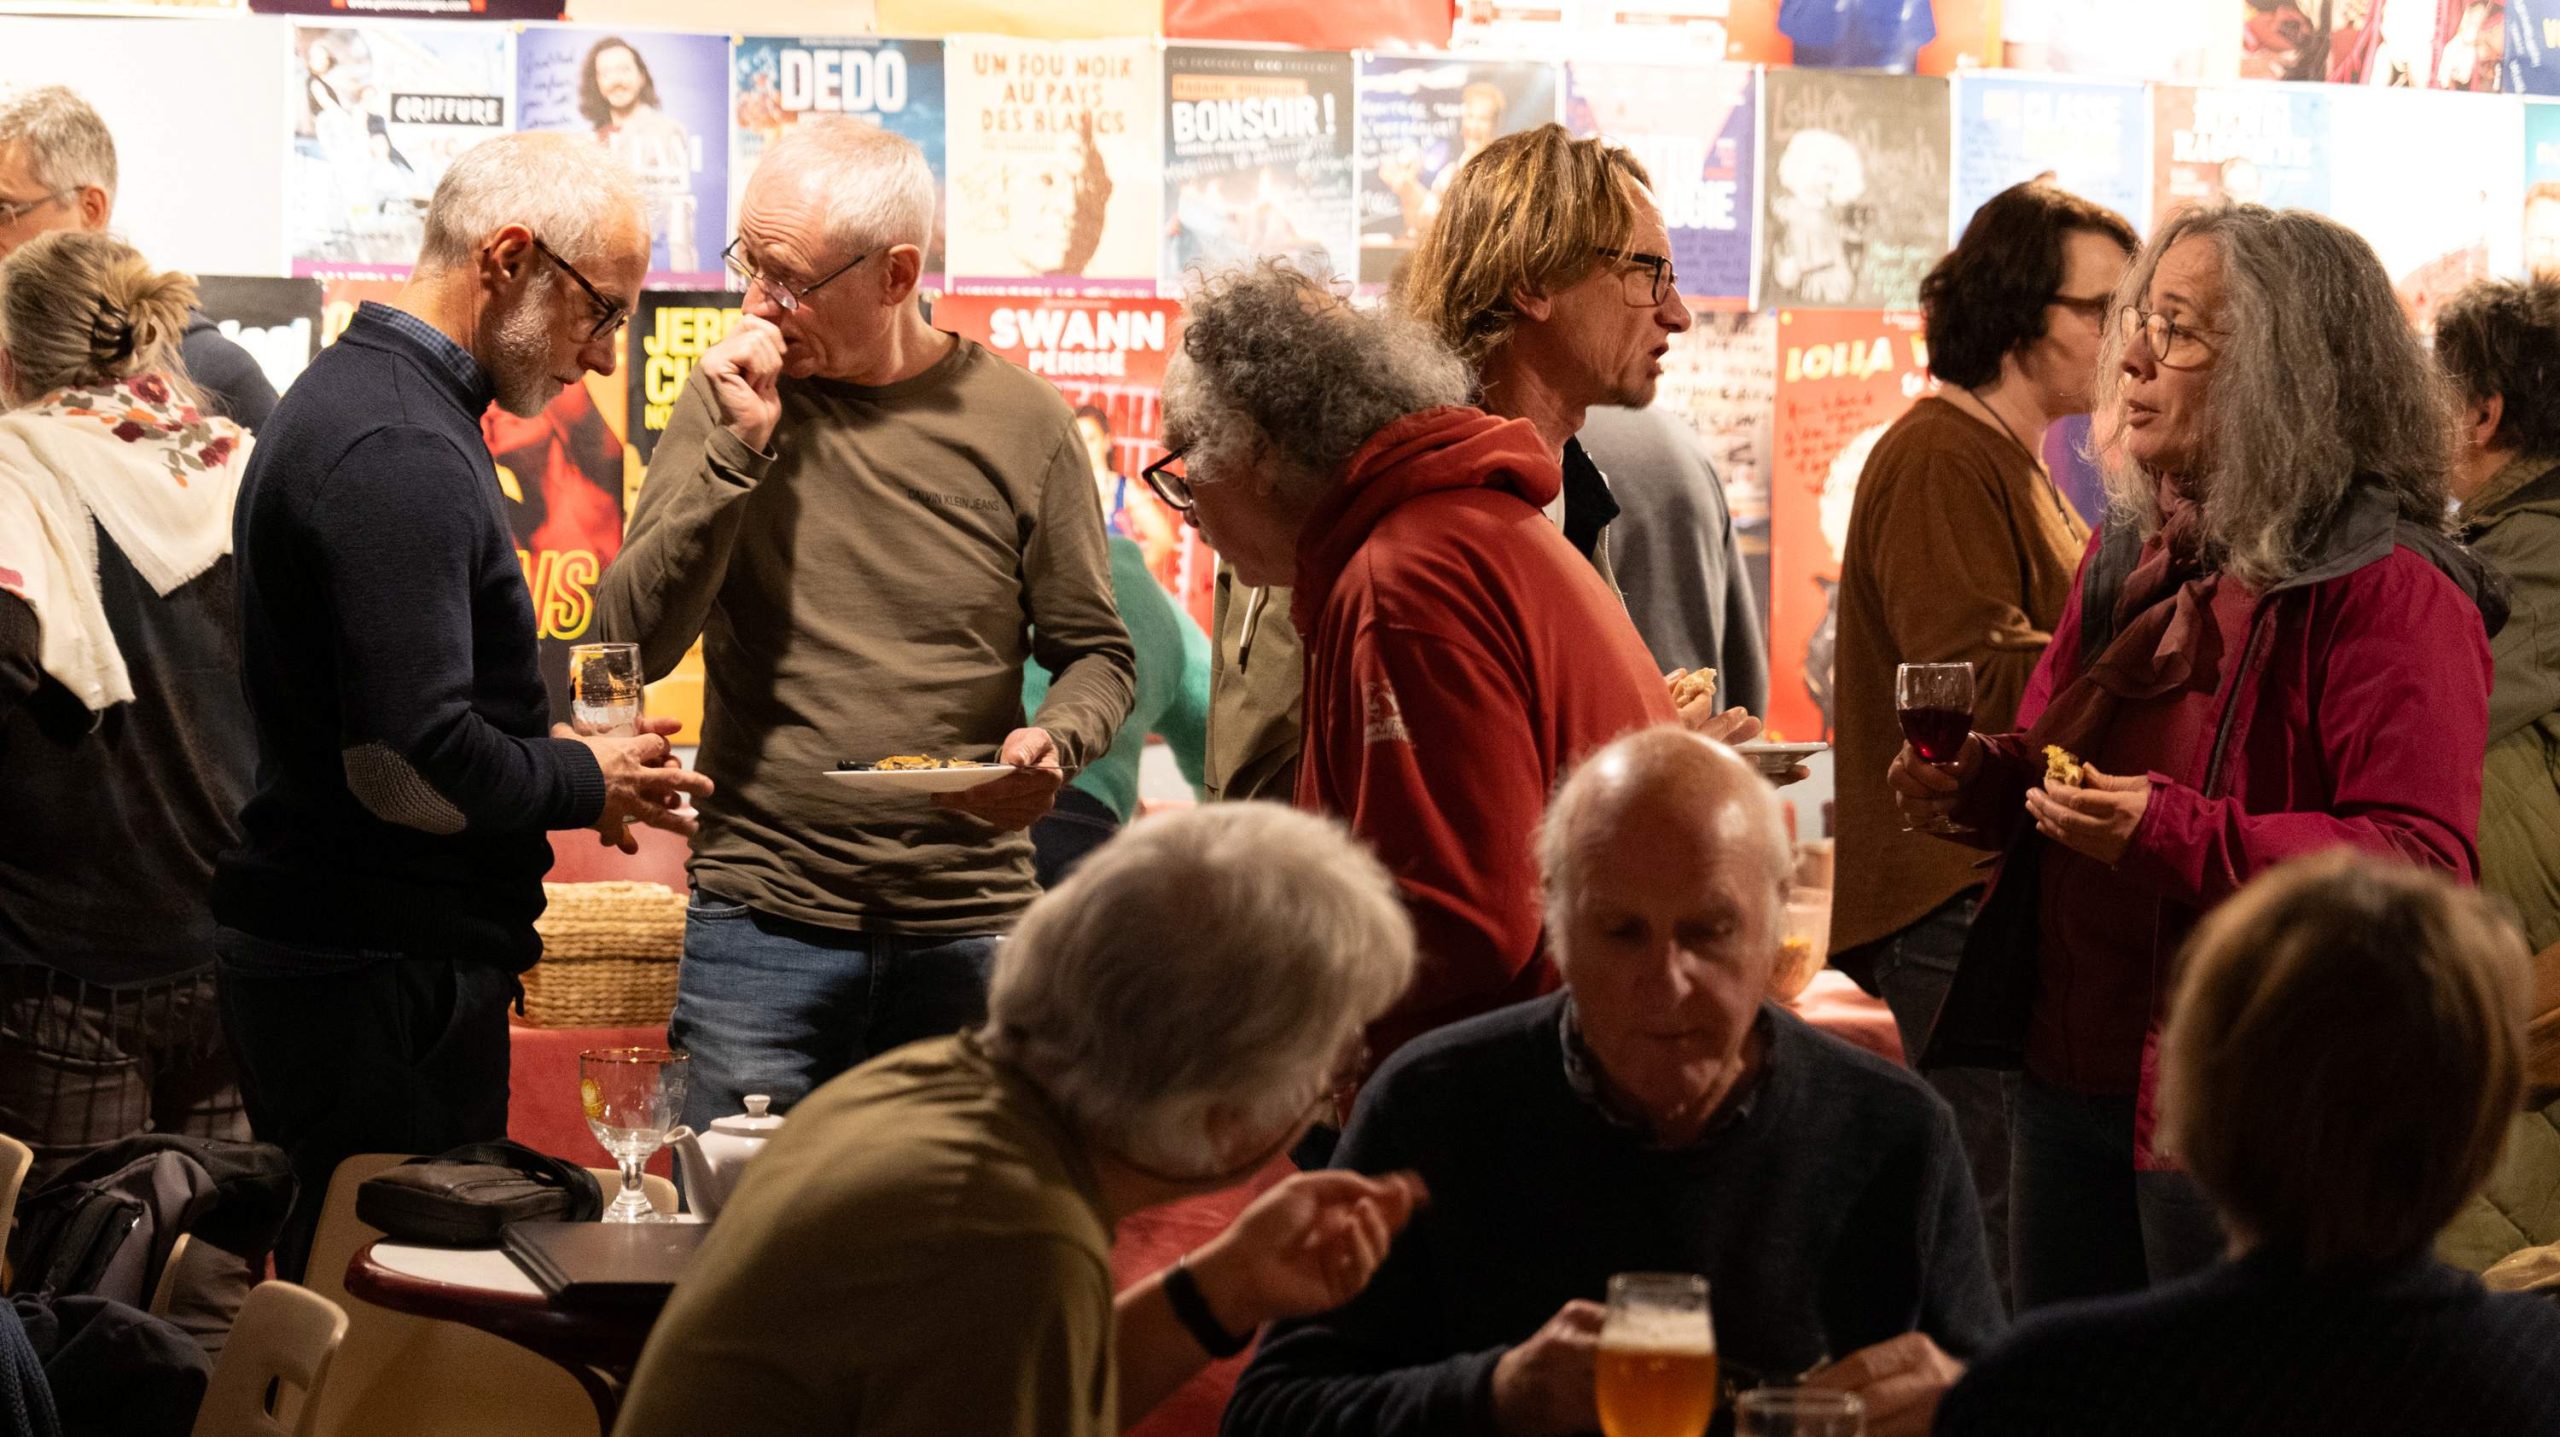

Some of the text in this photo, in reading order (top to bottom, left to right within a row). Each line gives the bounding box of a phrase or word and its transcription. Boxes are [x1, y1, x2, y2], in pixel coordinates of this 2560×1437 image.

[780, 49, 907, 112] DEDO
[973, 53, 1132, 79] UN FOU NOIR
[1004, 82, 1105, 108] AU PAYS
[395, 96, 500, 126] GRIFFURE
[981, 108, 1023, 133] DES
[1172, 94, 1319, 142] BONSOIR
[989, 307, 1166, 351] SWANN
[1785, 337, 1895, 383] LOLLA
[943, 494, 969, 510] KLEIN
[970, 498, 1000, 513] JEANS
